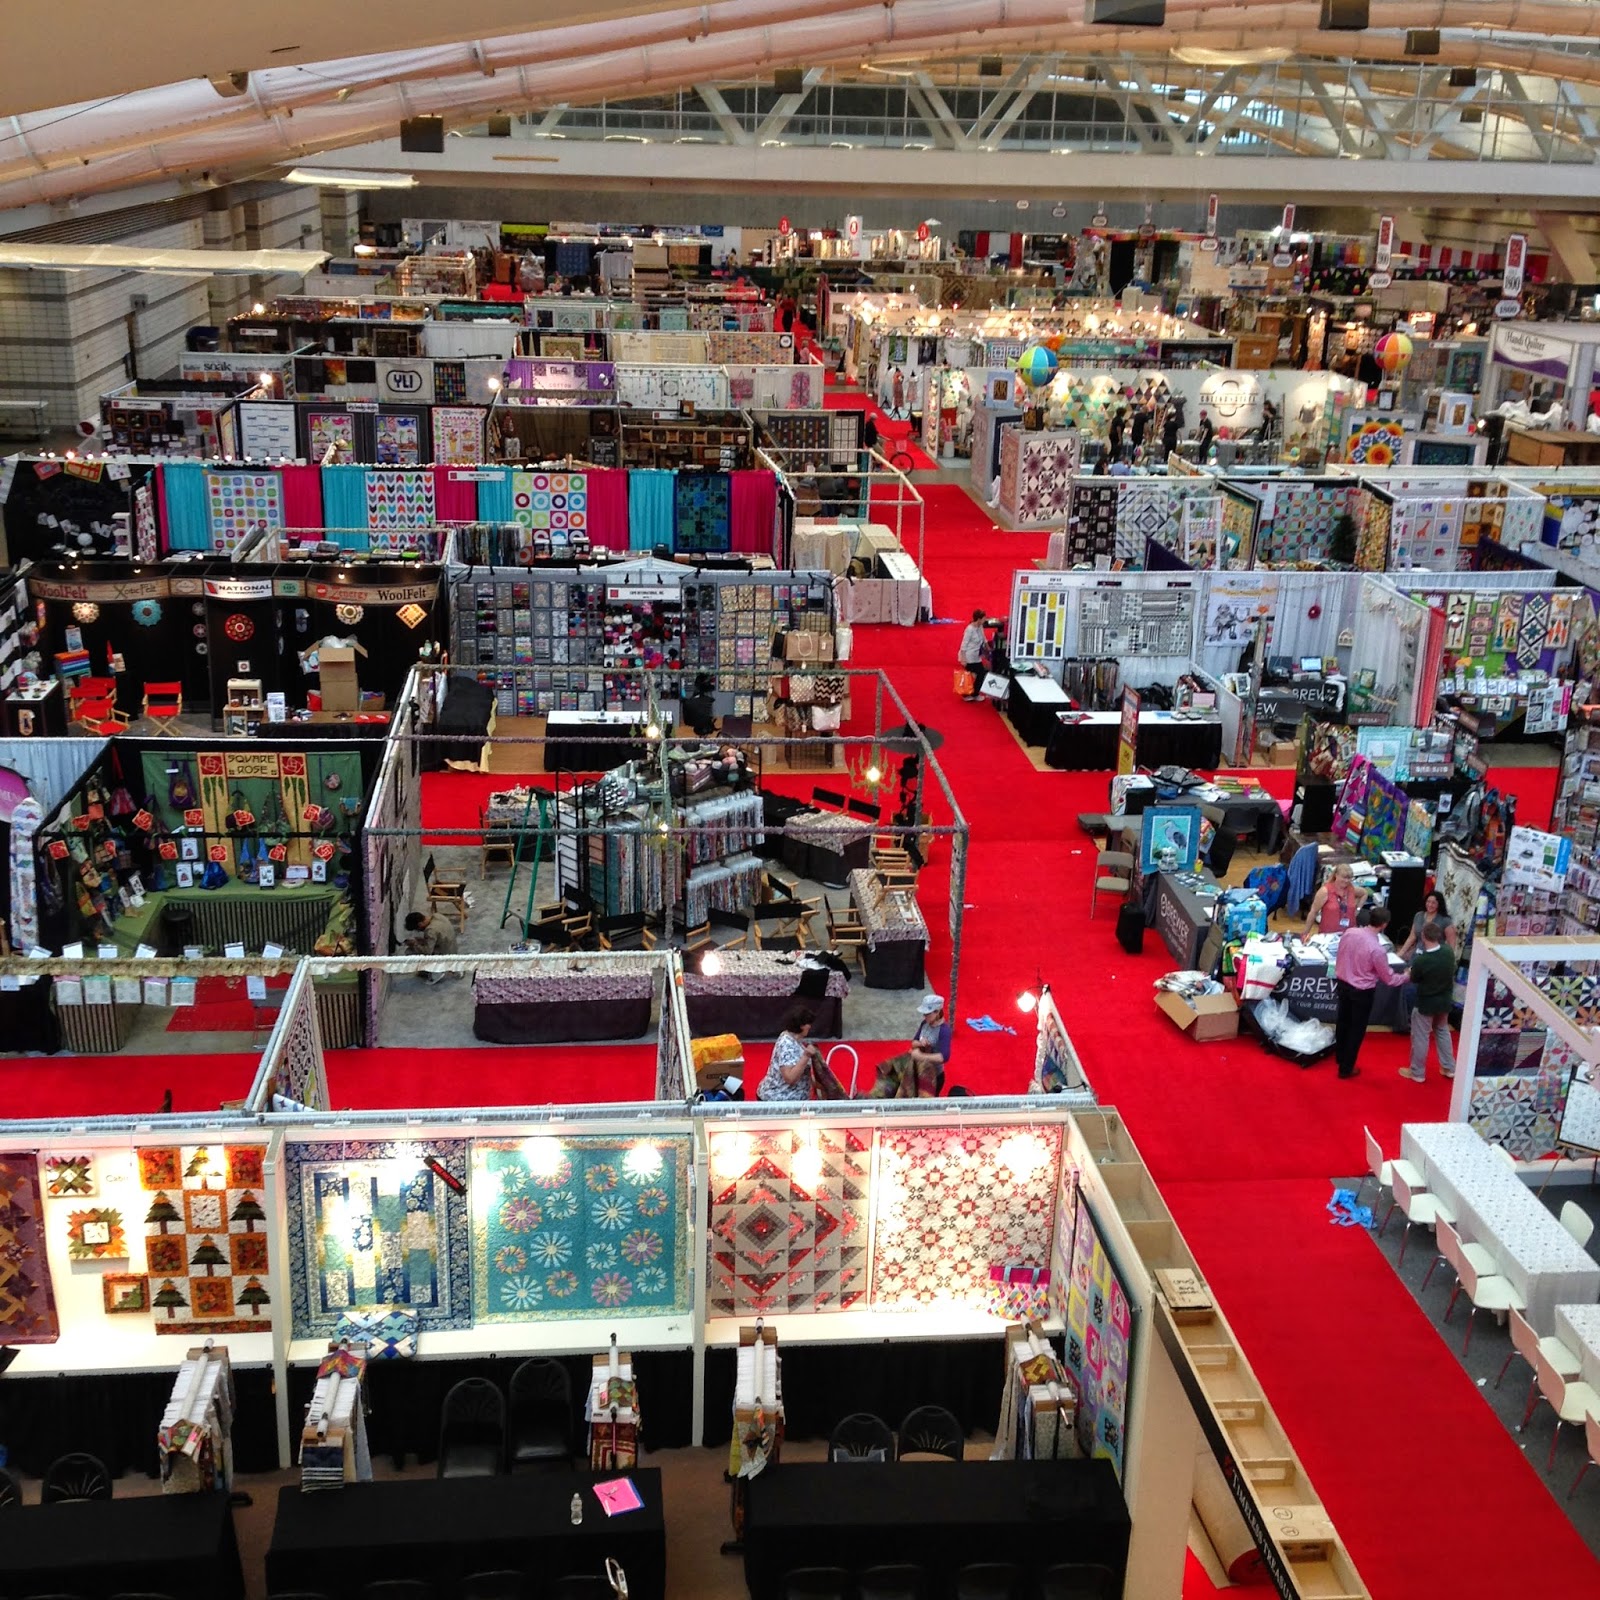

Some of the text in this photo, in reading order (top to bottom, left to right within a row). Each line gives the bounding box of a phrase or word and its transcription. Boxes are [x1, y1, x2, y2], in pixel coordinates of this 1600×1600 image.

[203, 361, 232, 371] soak
[393, 373, 413, 389] YLI
[36, 582, 88, 600] WoolFelt
[218, 583, 272, 592] NATIONAL
[377, 587, 427, 602] WoolFelt
[237, 765, 268, 775] ROSE
